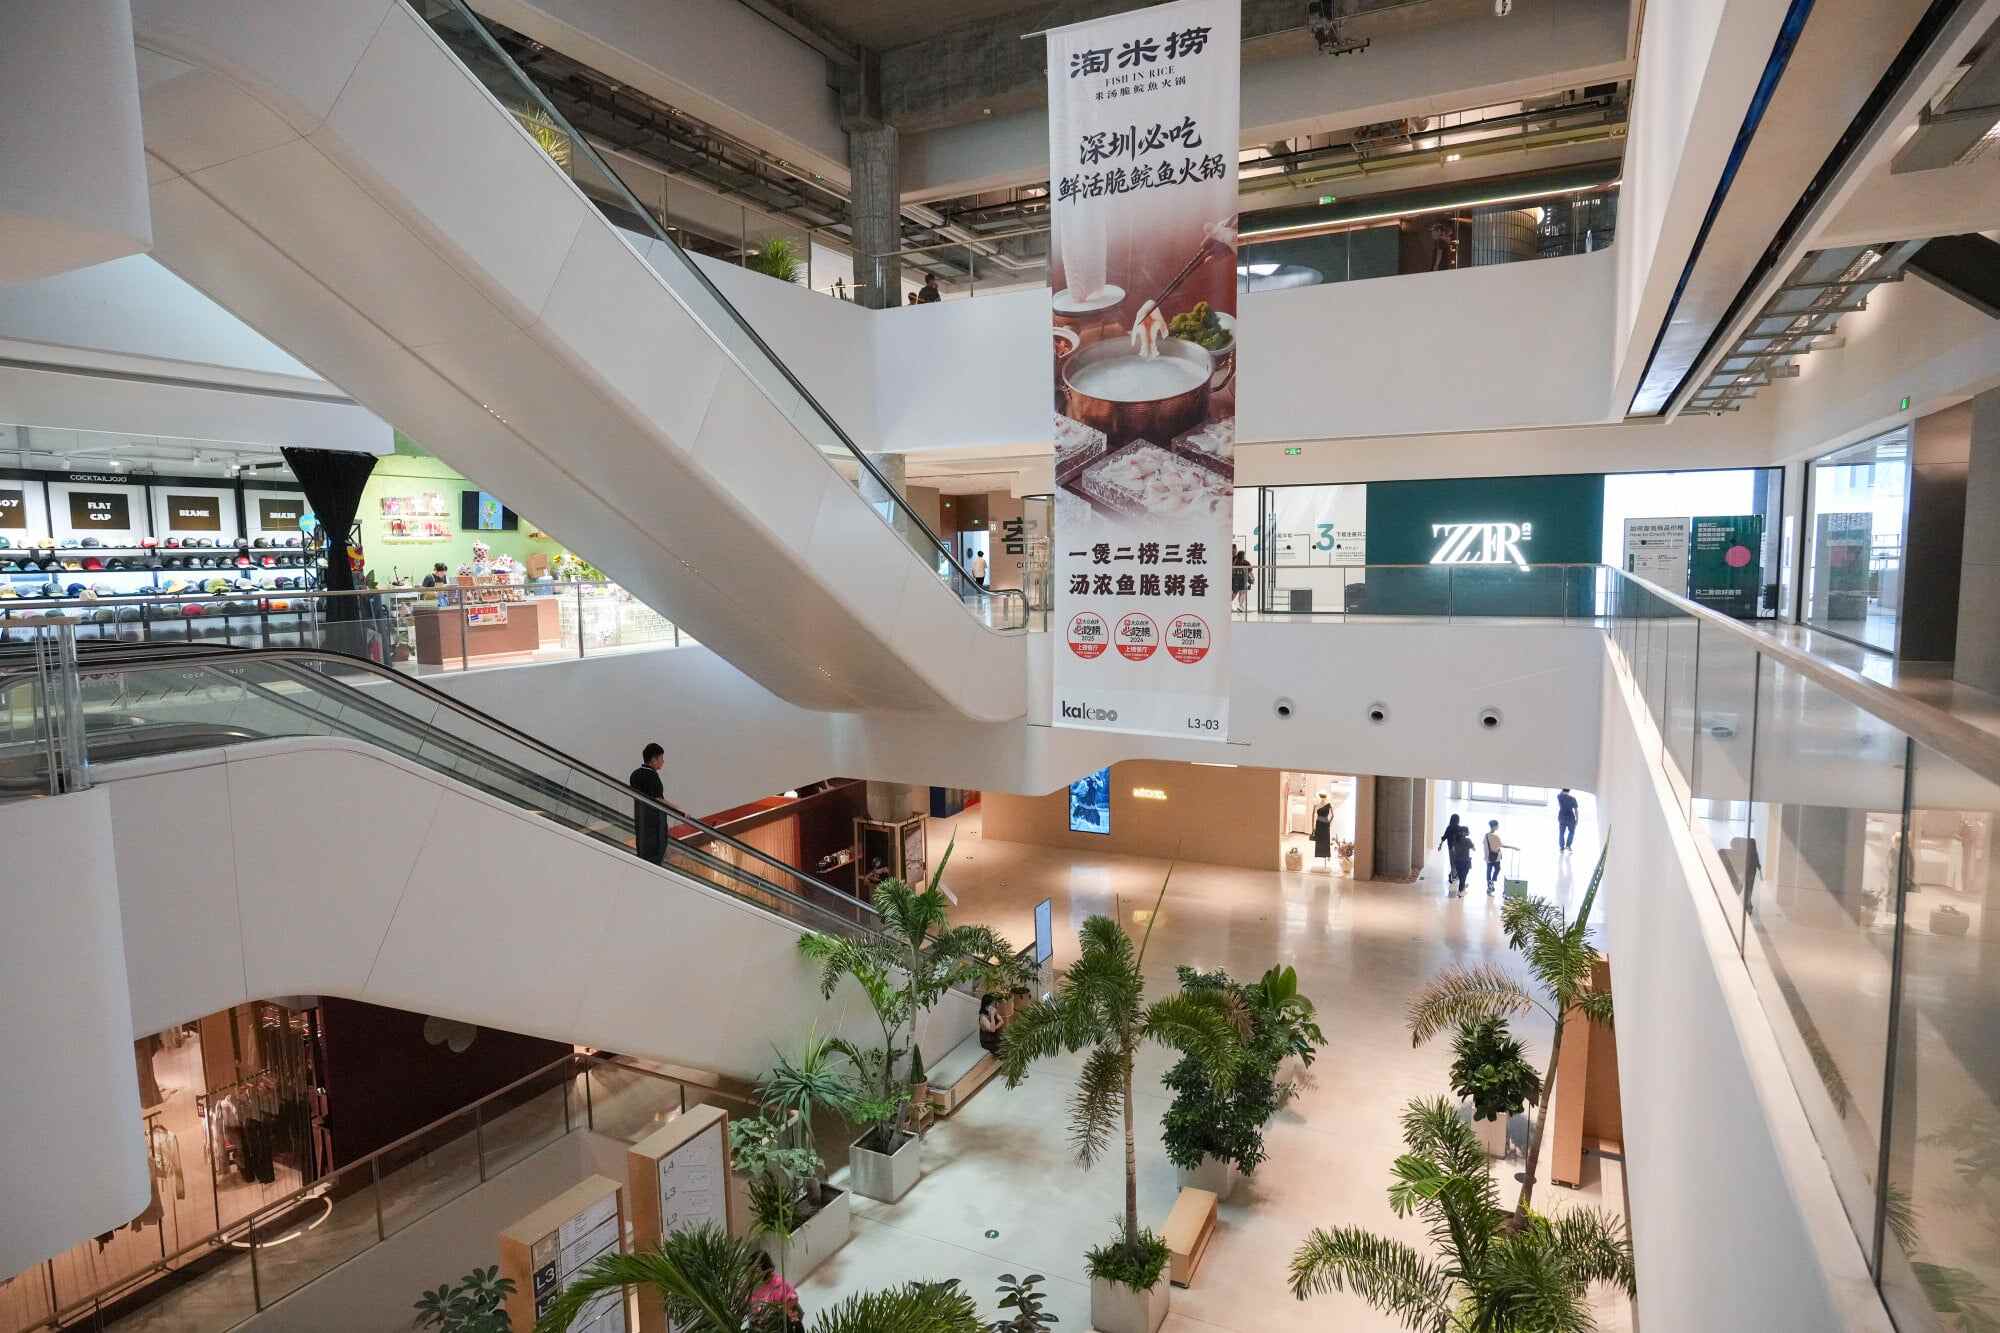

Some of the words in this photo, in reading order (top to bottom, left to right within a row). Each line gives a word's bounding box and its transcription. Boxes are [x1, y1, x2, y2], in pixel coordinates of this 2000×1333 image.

[1070, 26, 1212, 78] 淘米捞
[1105, 73, 1128, 87] FISH
[1133, 72, 1144, 81] IN
[1149, 65, 1176, 78] RICE
[1080, 116, 1202, 165] 深圳必吃
[1058, 153, 1226, 206] 鲜活脆鲩鱼火锅
[1316, 524, 1335, 550] 3
[1430, 523, 1530, 572] ZZER
[1069, 542, 1208, 565] 一煲二捞三煮
[1069, 573, 1209, 597] 汤浓鱼脆粥香
[1073, 625, 1100, 635] 必吃榜
[1122, 626, 1150, 637] 必吃榜
[1172, 628, 1202, 639] 必吃榜
[1188, 718, 1219, 730] L3-03
[665, 1186, 676, 1200] L3
[536, 1267, 555, 1290] L3
